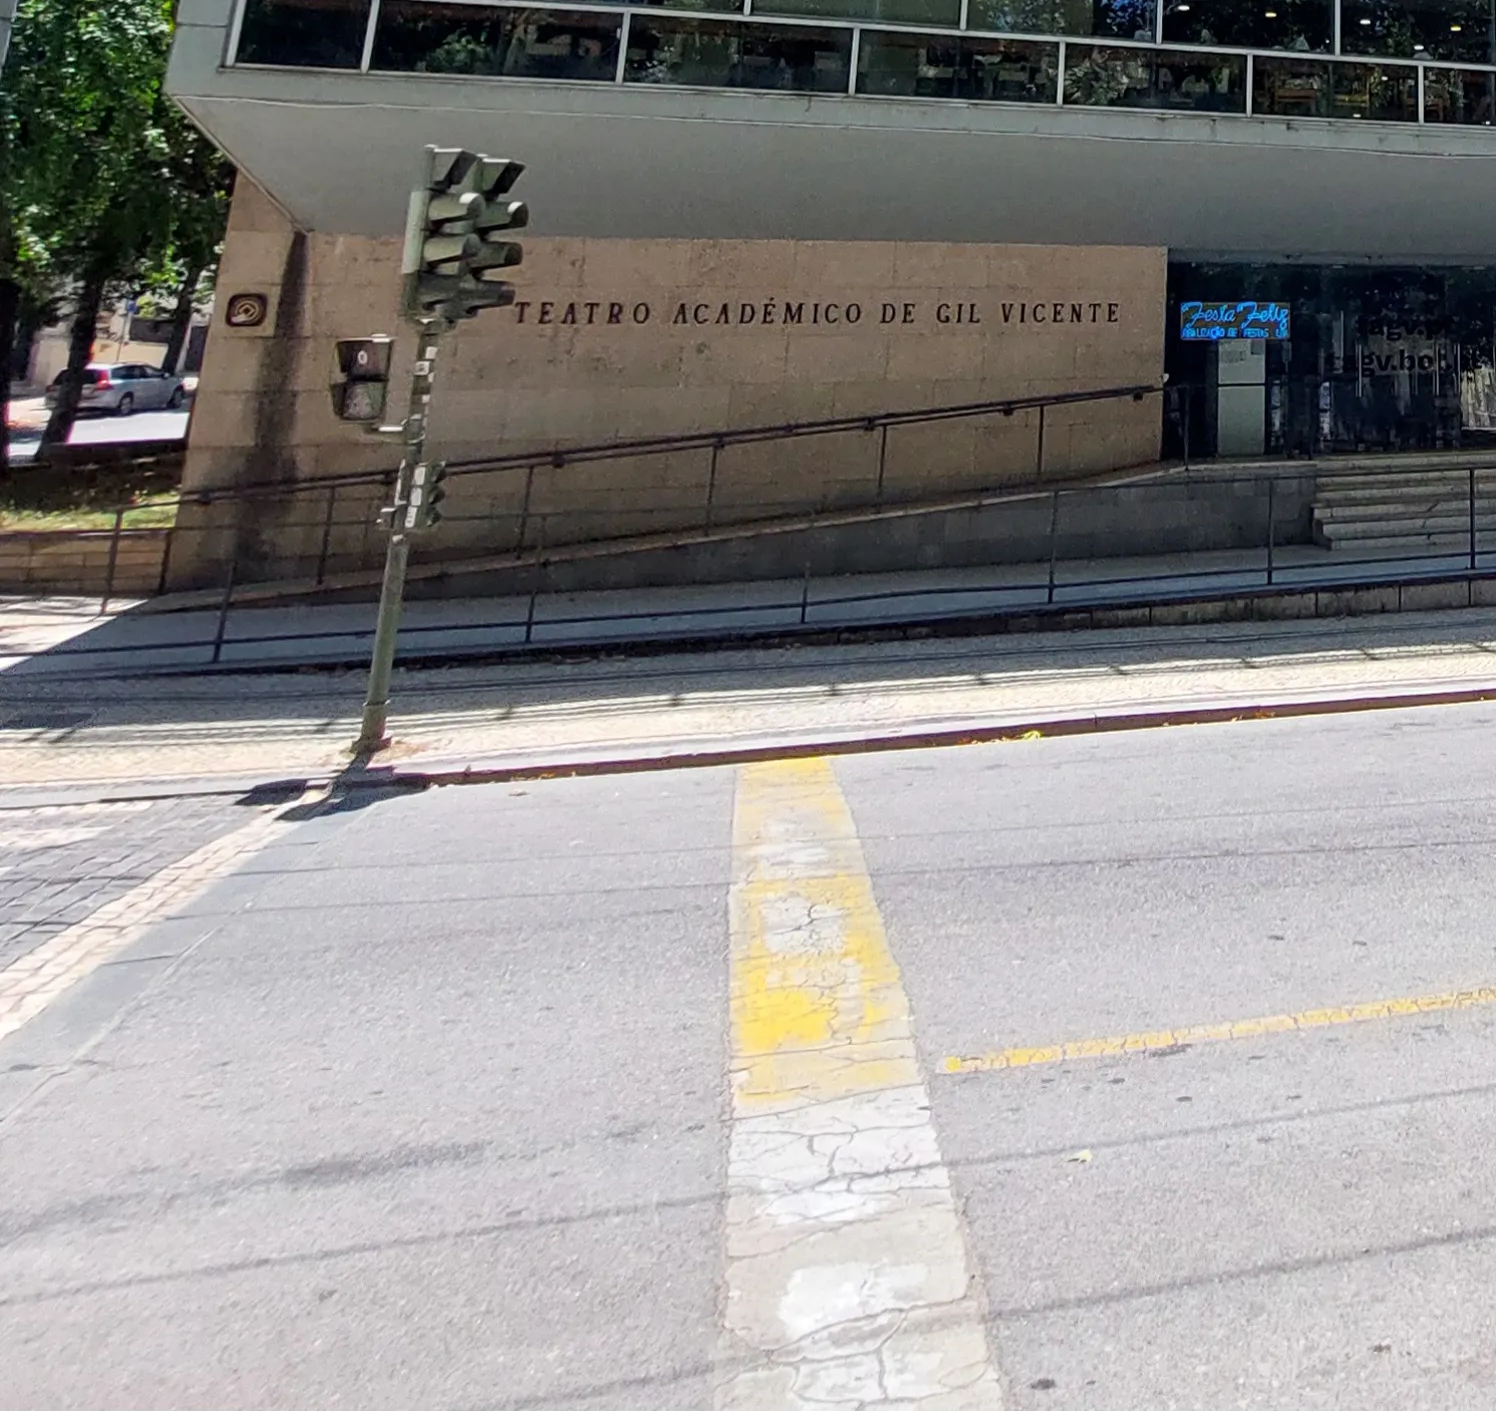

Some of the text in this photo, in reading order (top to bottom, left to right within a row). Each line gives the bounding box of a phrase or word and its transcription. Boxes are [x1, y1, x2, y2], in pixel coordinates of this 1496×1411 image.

[514, 297, 1119, 324] TEATRO ACADÉMICO DE GIL VICENTE
